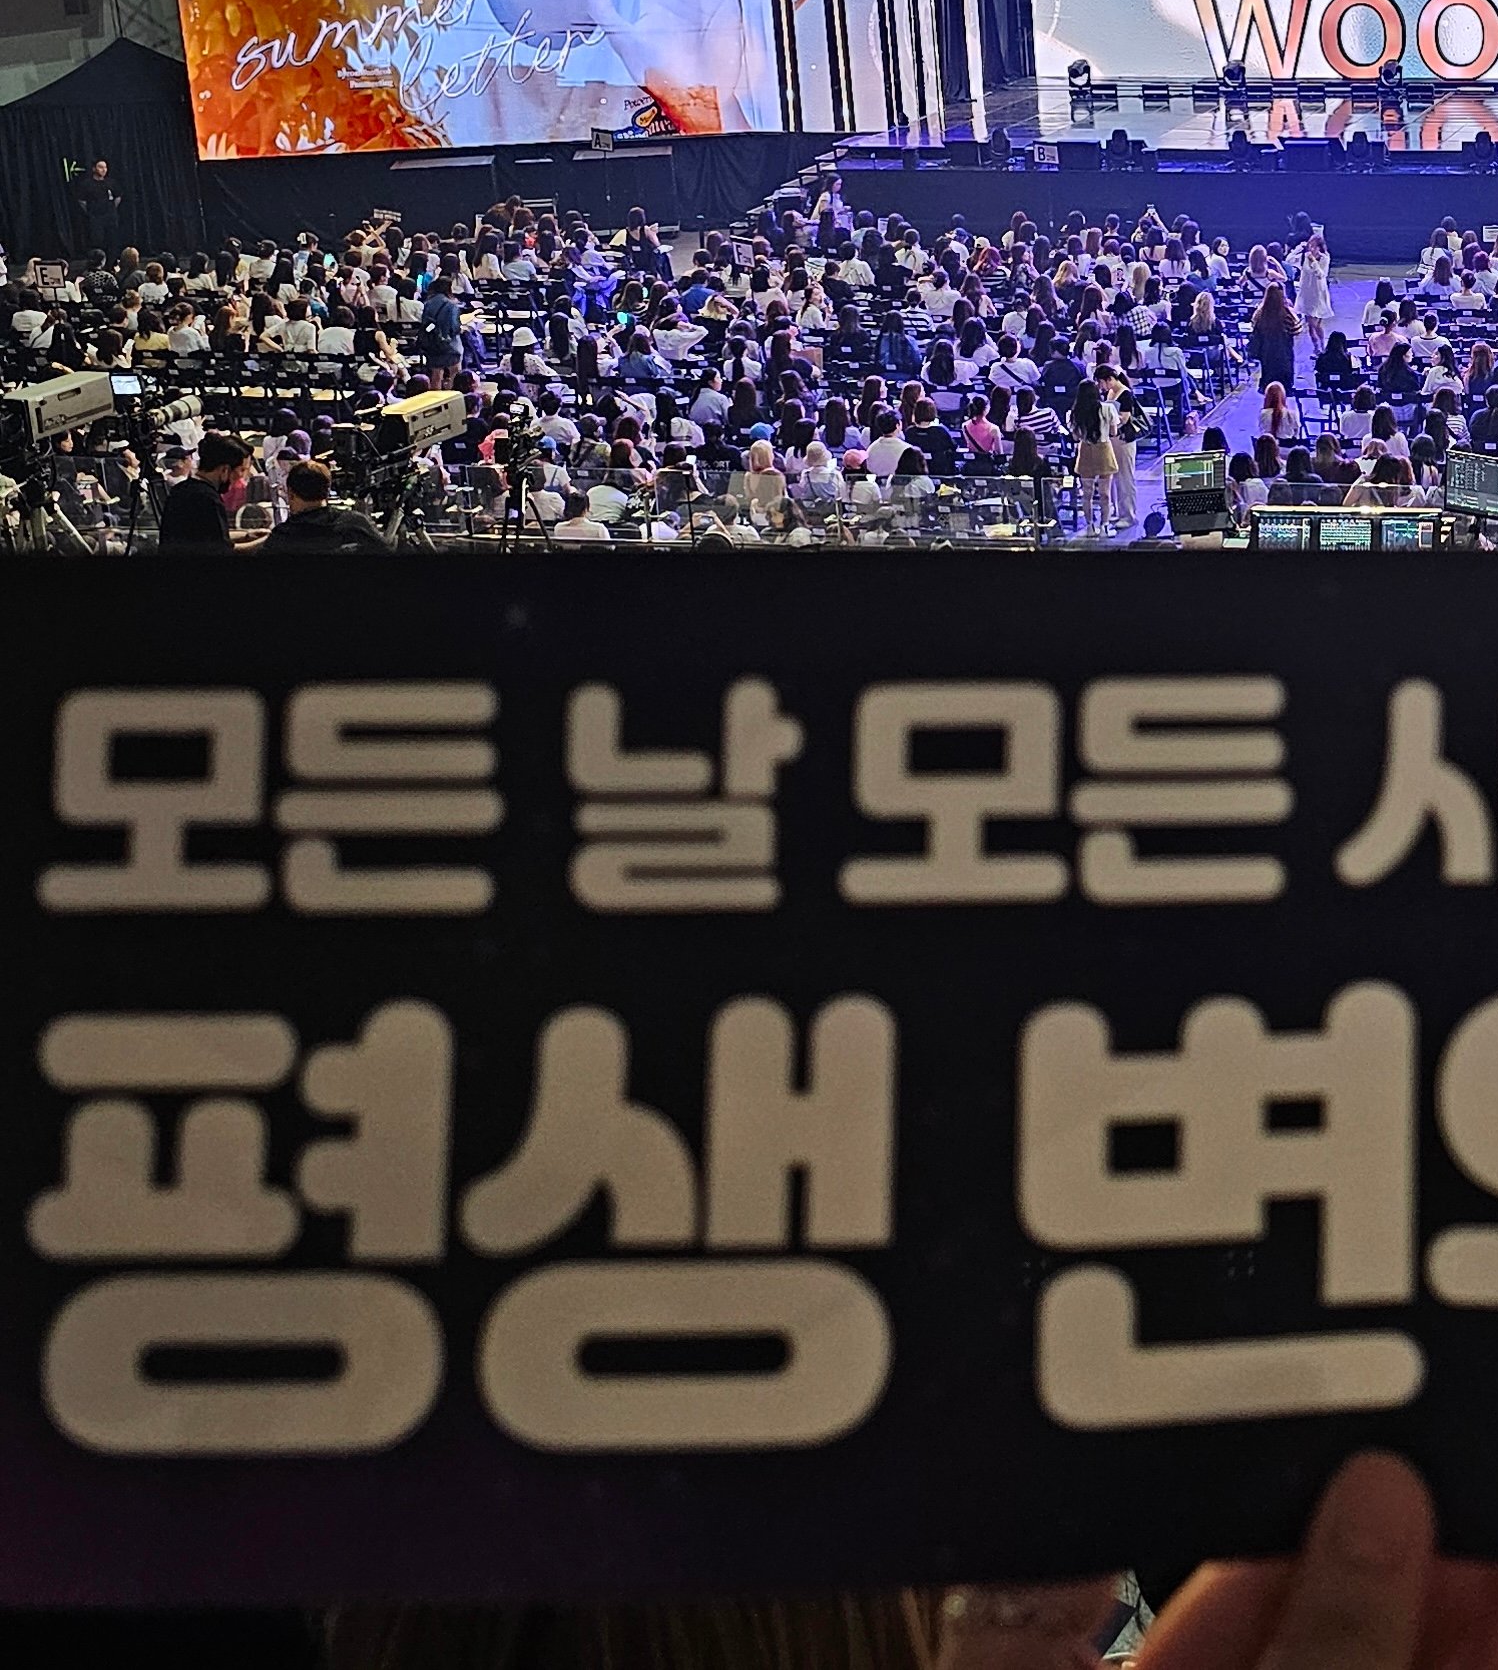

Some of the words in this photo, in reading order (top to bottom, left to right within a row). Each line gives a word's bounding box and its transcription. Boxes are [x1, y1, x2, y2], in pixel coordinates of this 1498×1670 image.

[398, 10, 605, 113] letter
[35, 678, 505, 915] 모든
[565, 673, 806, 915] 날
[836, 671, 1295, 907] 모든
[26, 993, 898, 1458] 평생
